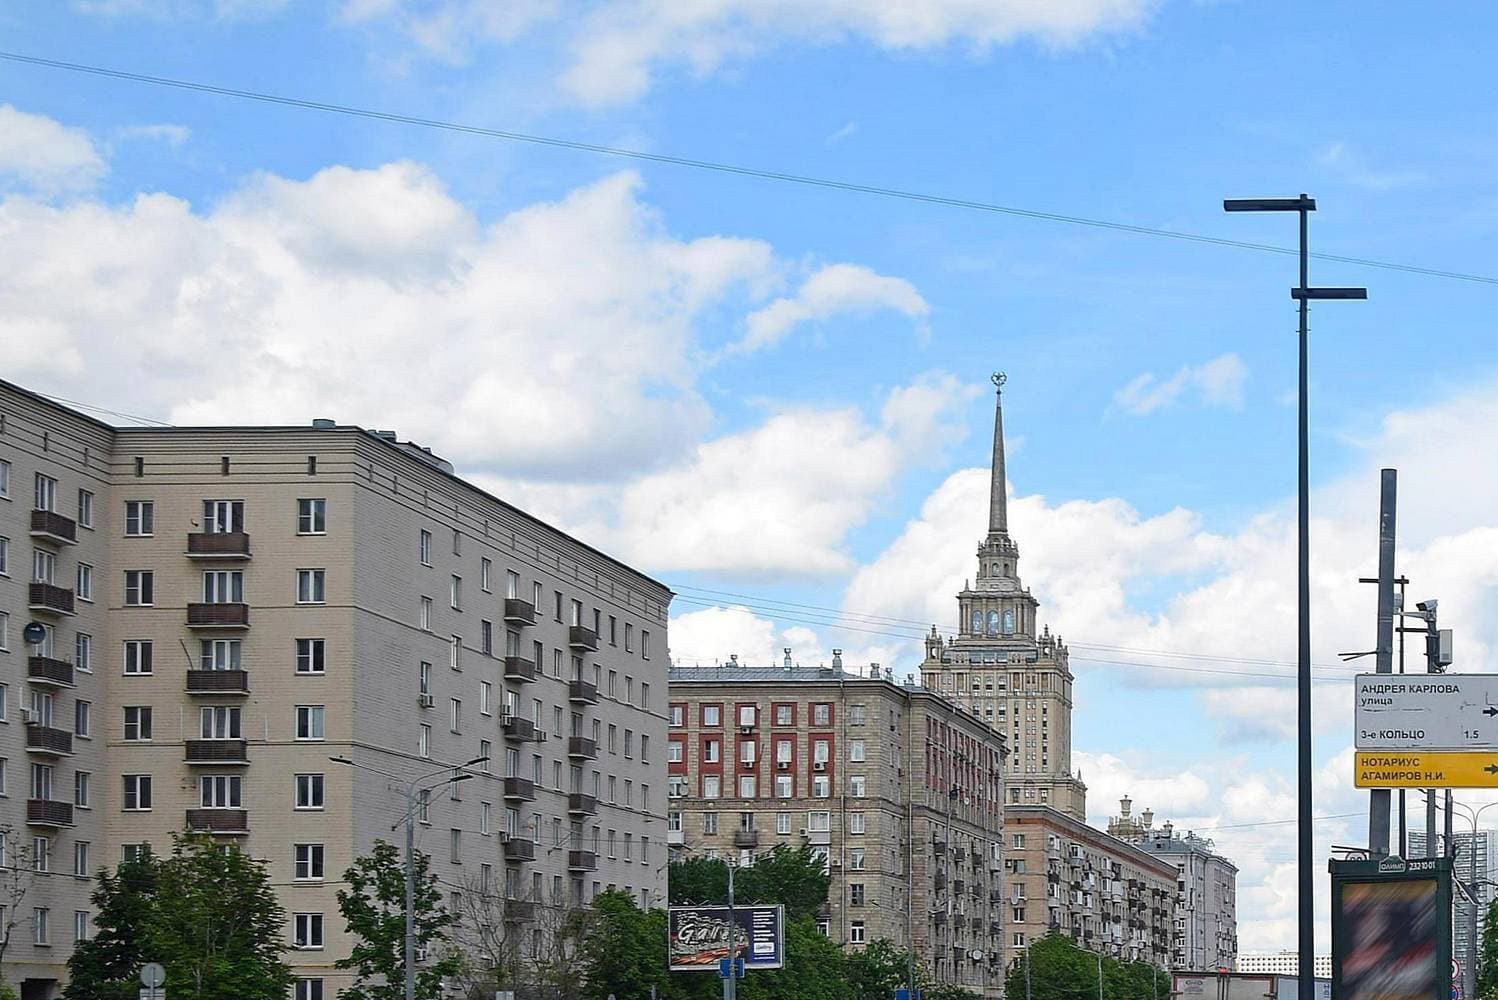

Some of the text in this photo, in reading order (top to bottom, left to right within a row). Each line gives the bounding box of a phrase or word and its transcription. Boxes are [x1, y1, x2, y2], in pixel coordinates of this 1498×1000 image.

[1361, 685, 1460, 694] АНДРЕЯ КАРЛОВА
[1361, 697, 1393, 706] улица
[1361, 730, 1479, 740] 3-е КОЛЬЦО 1.5
[1361, 758, 1420, 767] НОТАРИУС
[1361, 771, 1446, 780] АГАМИРОВ Н.И.
